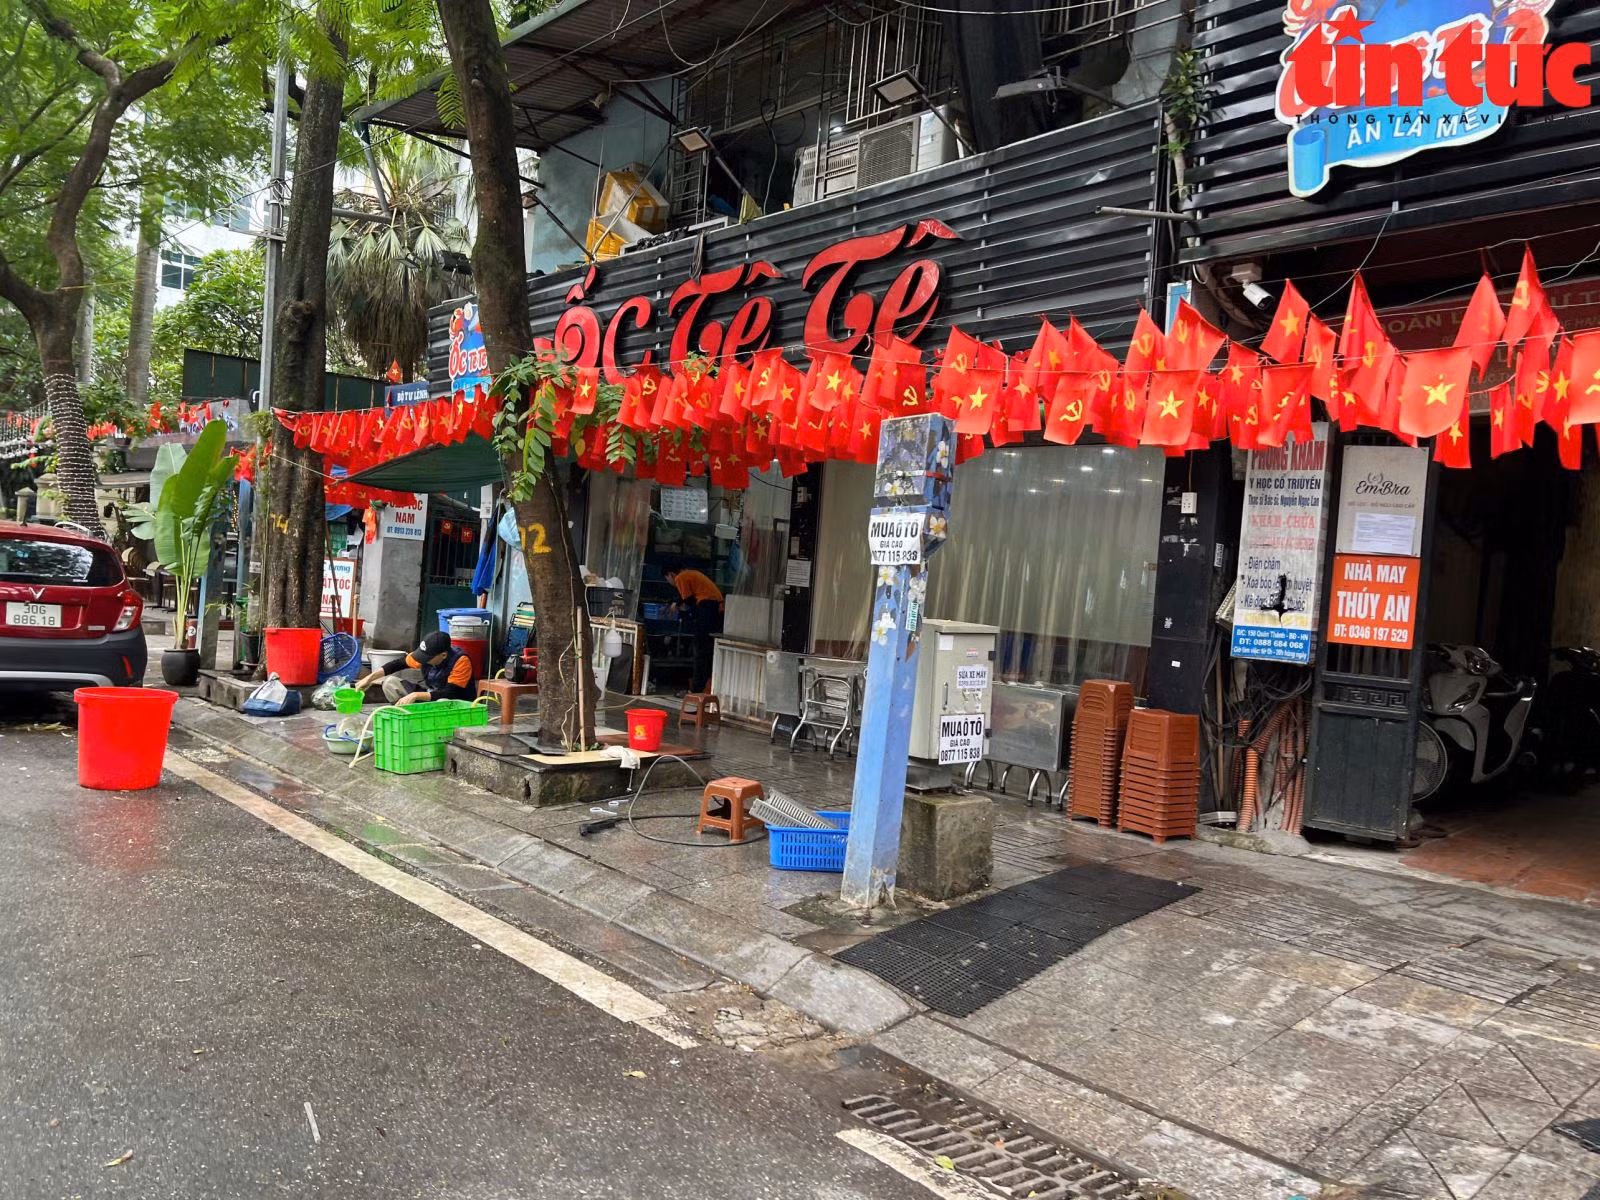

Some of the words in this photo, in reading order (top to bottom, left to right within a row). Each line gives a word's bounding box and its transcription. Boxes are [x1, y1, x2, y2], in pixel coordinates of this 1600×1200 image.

[1256, 478, 1272, 491] HỌC
[1355, 480, 1411, 495] EmBra
[395, 512, 415, 524] NAM
[519, 522, 552, 554] 12
[888, 550, 900, 562] 115
[1344, 560, 1372, 581] NHÀ
[1376, 564, 1407, 584] MAY
[24, 605, 46, 614] 30G
[1337, 587, 1380, 620] THÚY
[1383, 594, 1411, 622] AN
[14, 615, 55, 626] 886.18
[1348, 624, 1370, 640] 0346
[1373, 627, 1390, 640] 197
[1391, 628, 1408, 643] 529
[960, 739, 970, 747] CAO
[941, 750, 956, 761] 0877
[957, 748, 968, 759] 115
